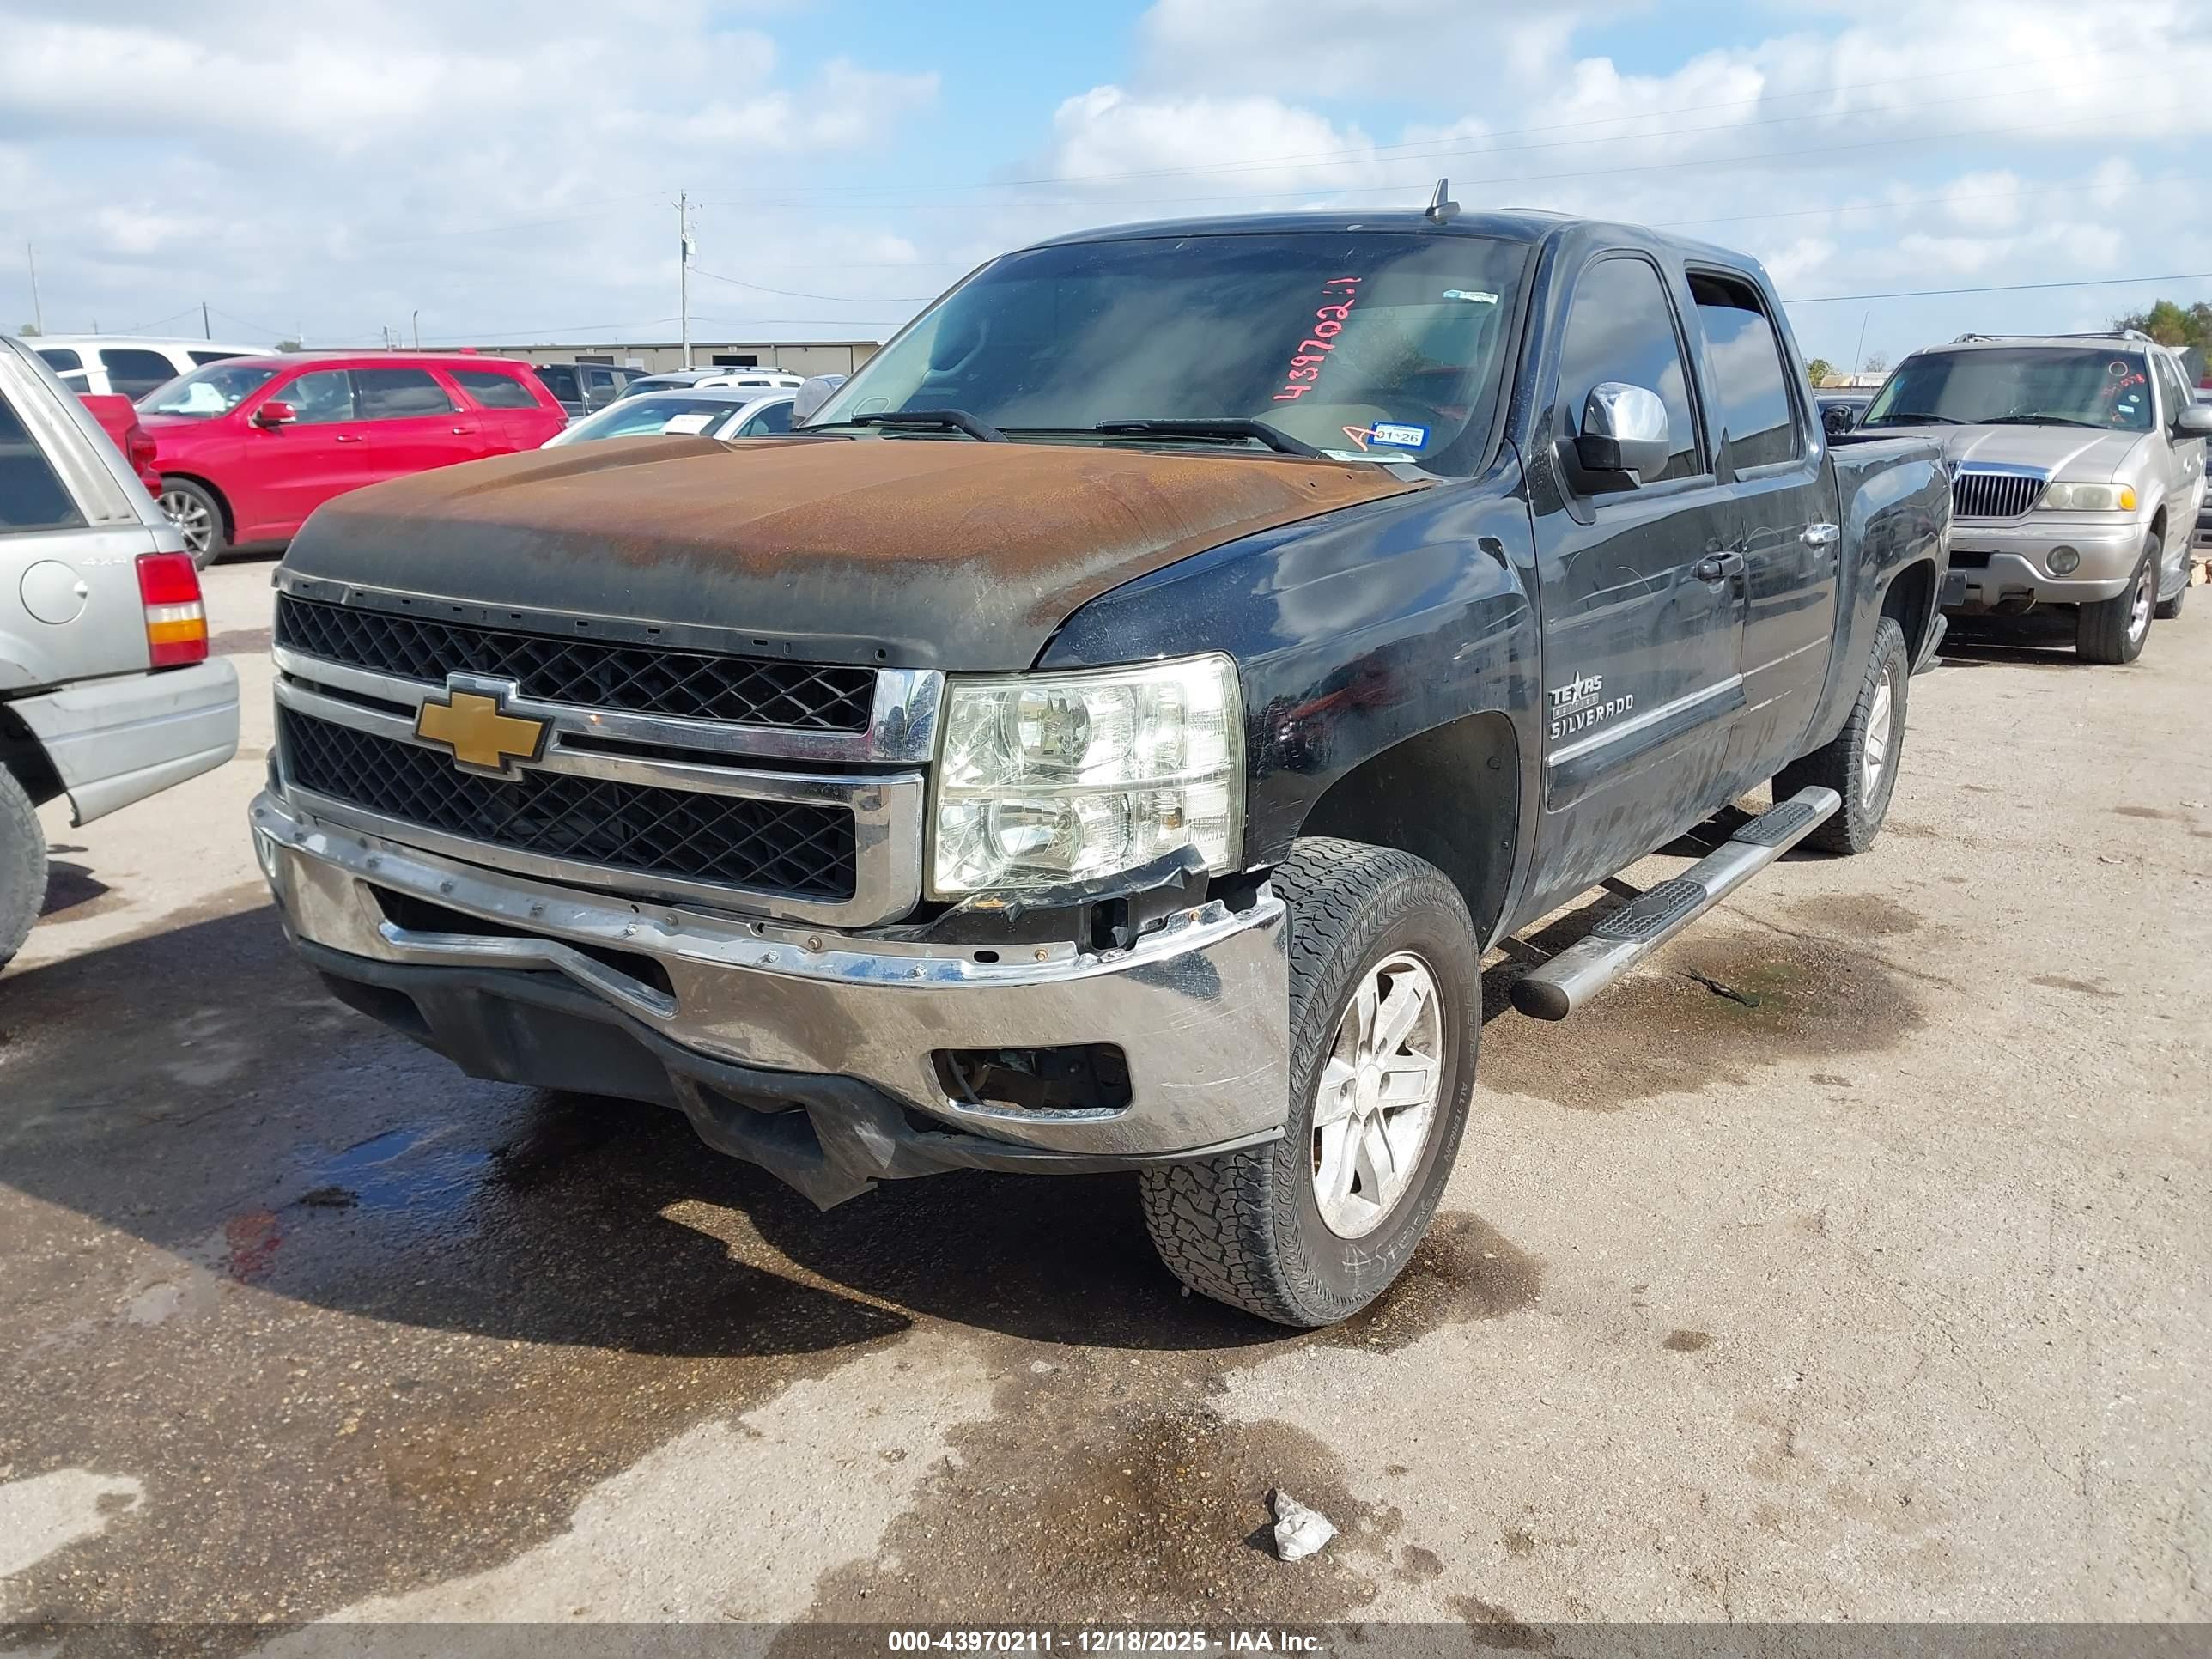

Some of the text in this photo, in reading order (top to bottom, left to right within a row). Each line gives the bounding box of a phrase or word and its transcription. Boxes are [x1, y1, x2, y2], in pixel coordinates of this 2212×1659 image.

[1550, 671, 1603, 706] TEXAS
[1550, 694, 1635, 740] SILVERADO
[1443, 1081, 1468, 1162] ALL-TERRAIN
